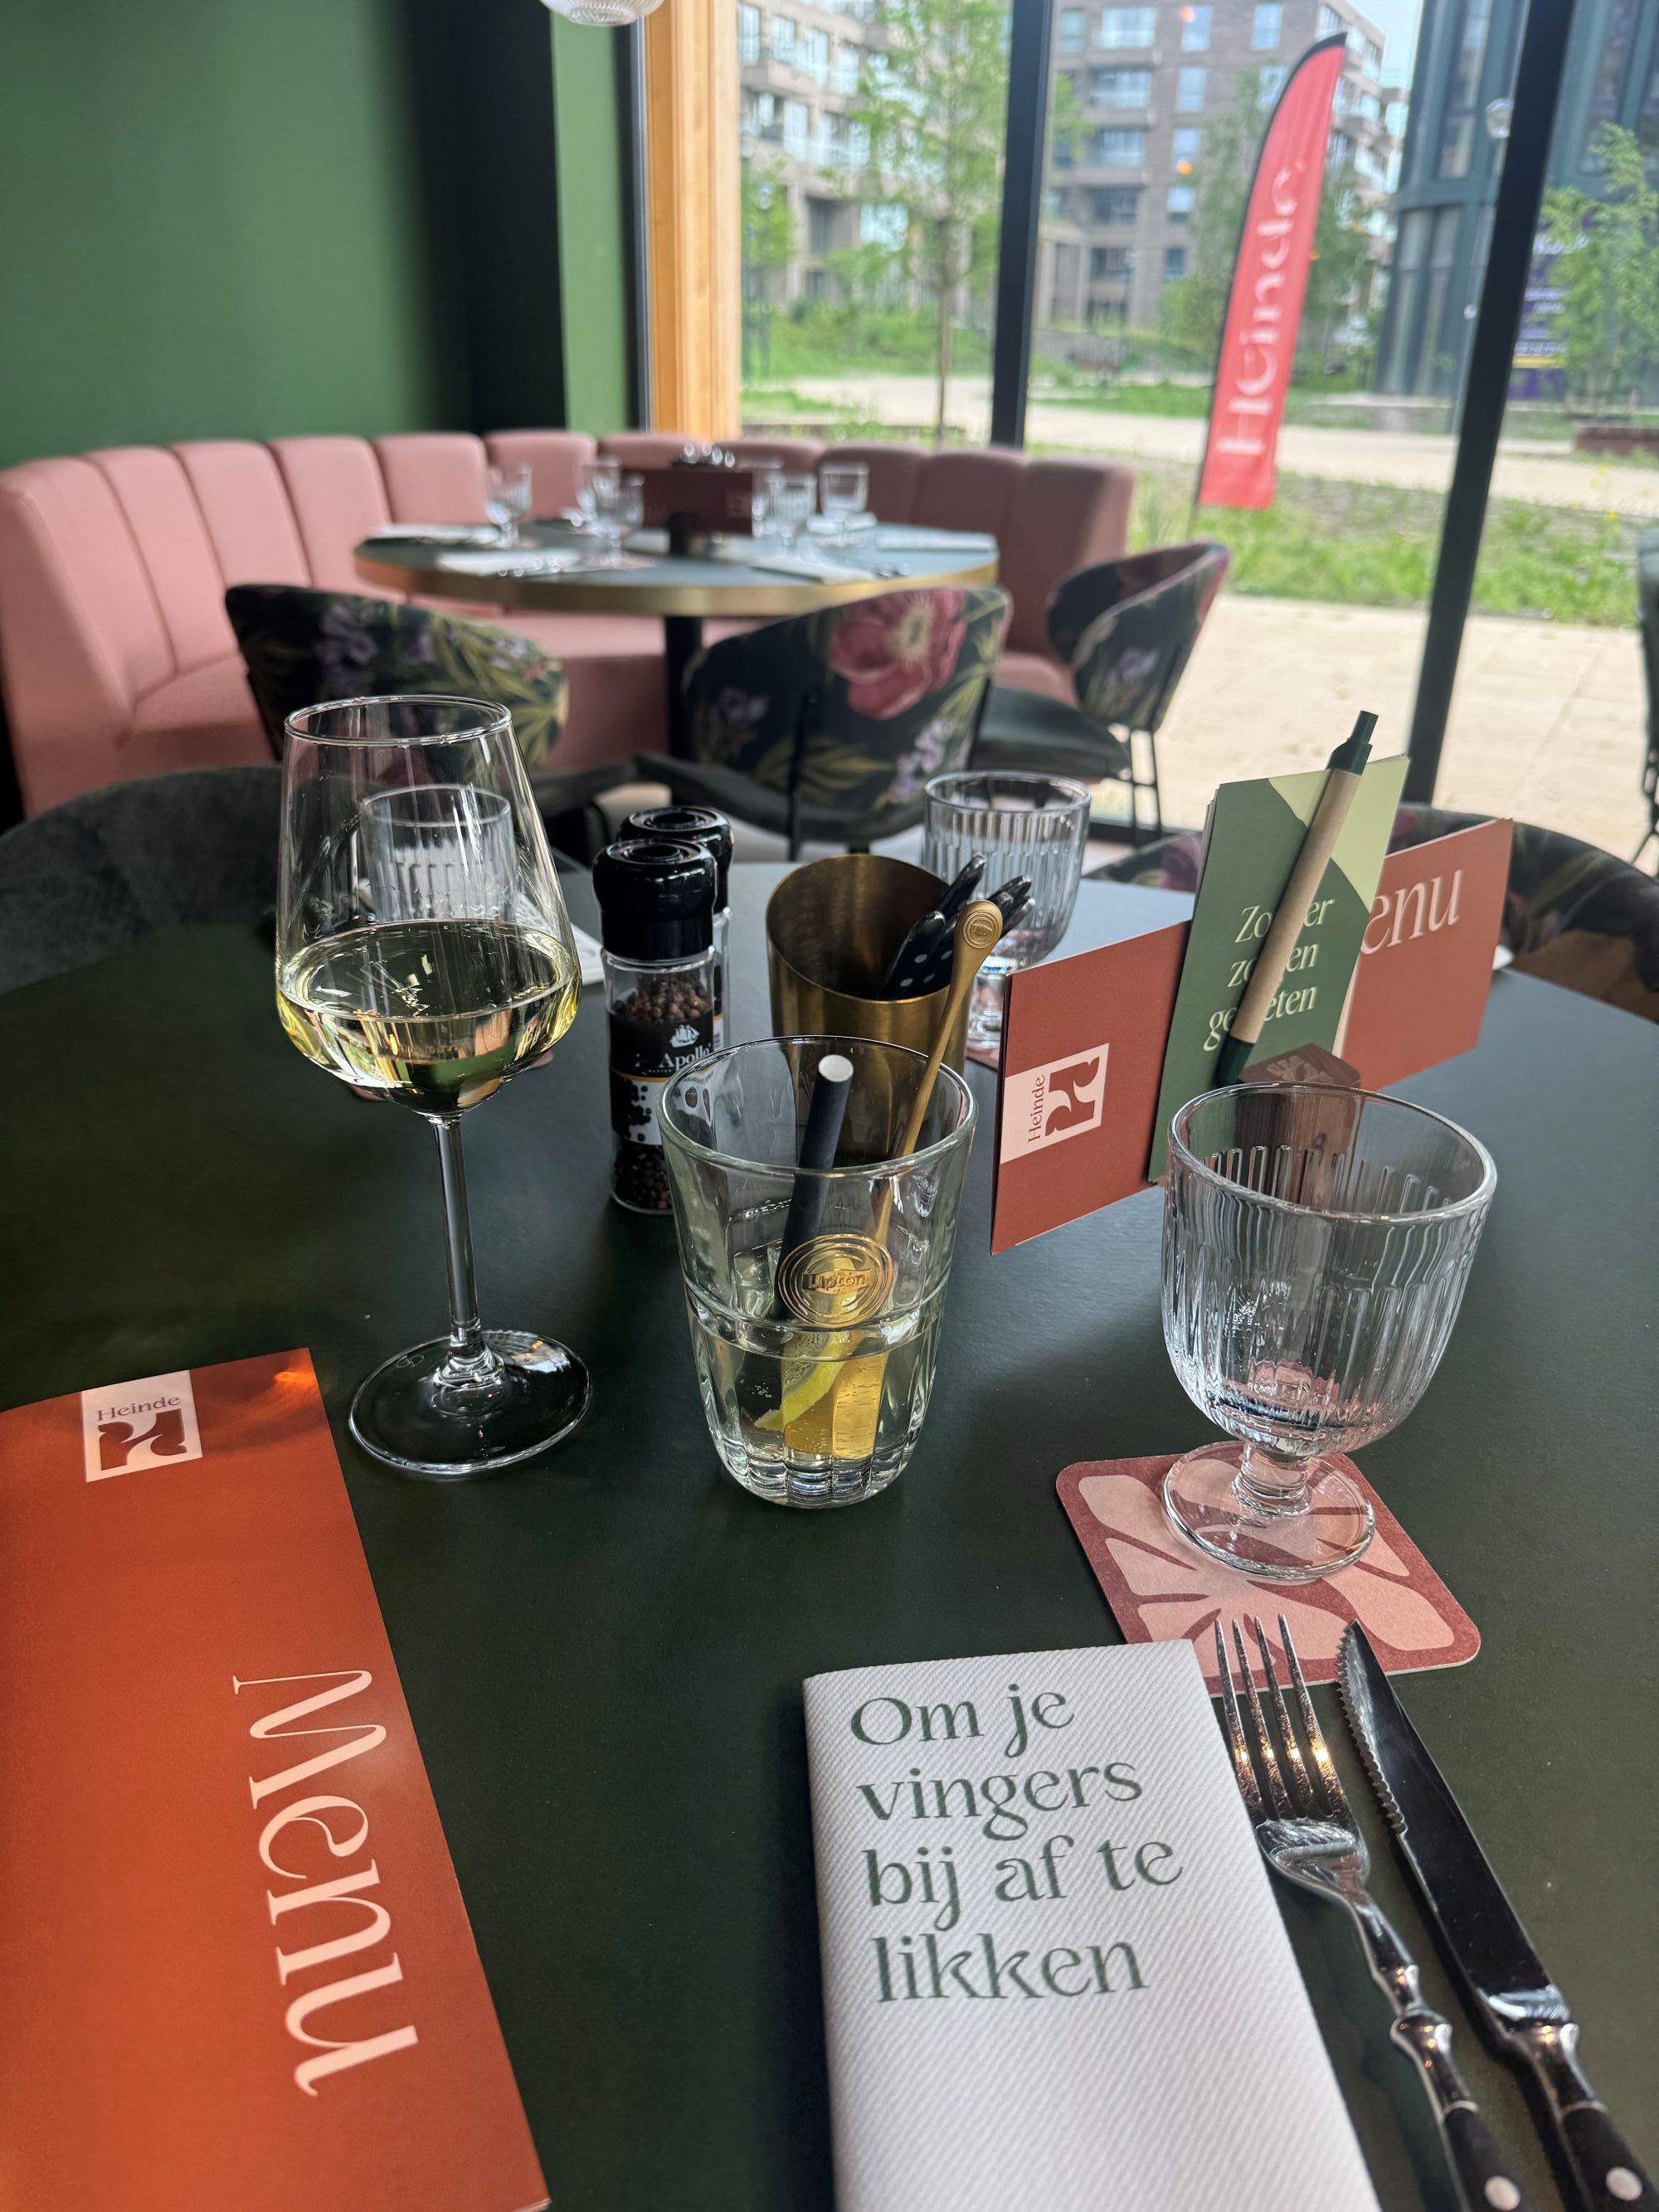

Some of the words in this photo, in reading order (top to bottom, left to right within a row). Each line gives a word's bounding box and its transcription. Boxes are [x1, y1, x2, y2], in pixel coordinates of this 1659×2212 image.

[1234, 898, 1335, 944] Zoer
[1360, 868, 1463, 955] enu
[1203, 985, 1318, 1052] geeten
[1028, 1074, 1045, 1143] Heinde
[808, 1273, 867, 1291] Lipton
[97, 1397, 182, 1422] Heinde
[850, 1696, 985, 1745] Om
[1004, 1683, 1075, 1758] je
[856, 1762, 1144, 1841] vingers
[232, 1669, 419, 2097] Menu
[861, 1845, 961, 1932] bij
[995, 1835, 1075, 1902] af
[1097, 1837, 1184, 1892] te
[872, 1932, 1150, 2003] likken
